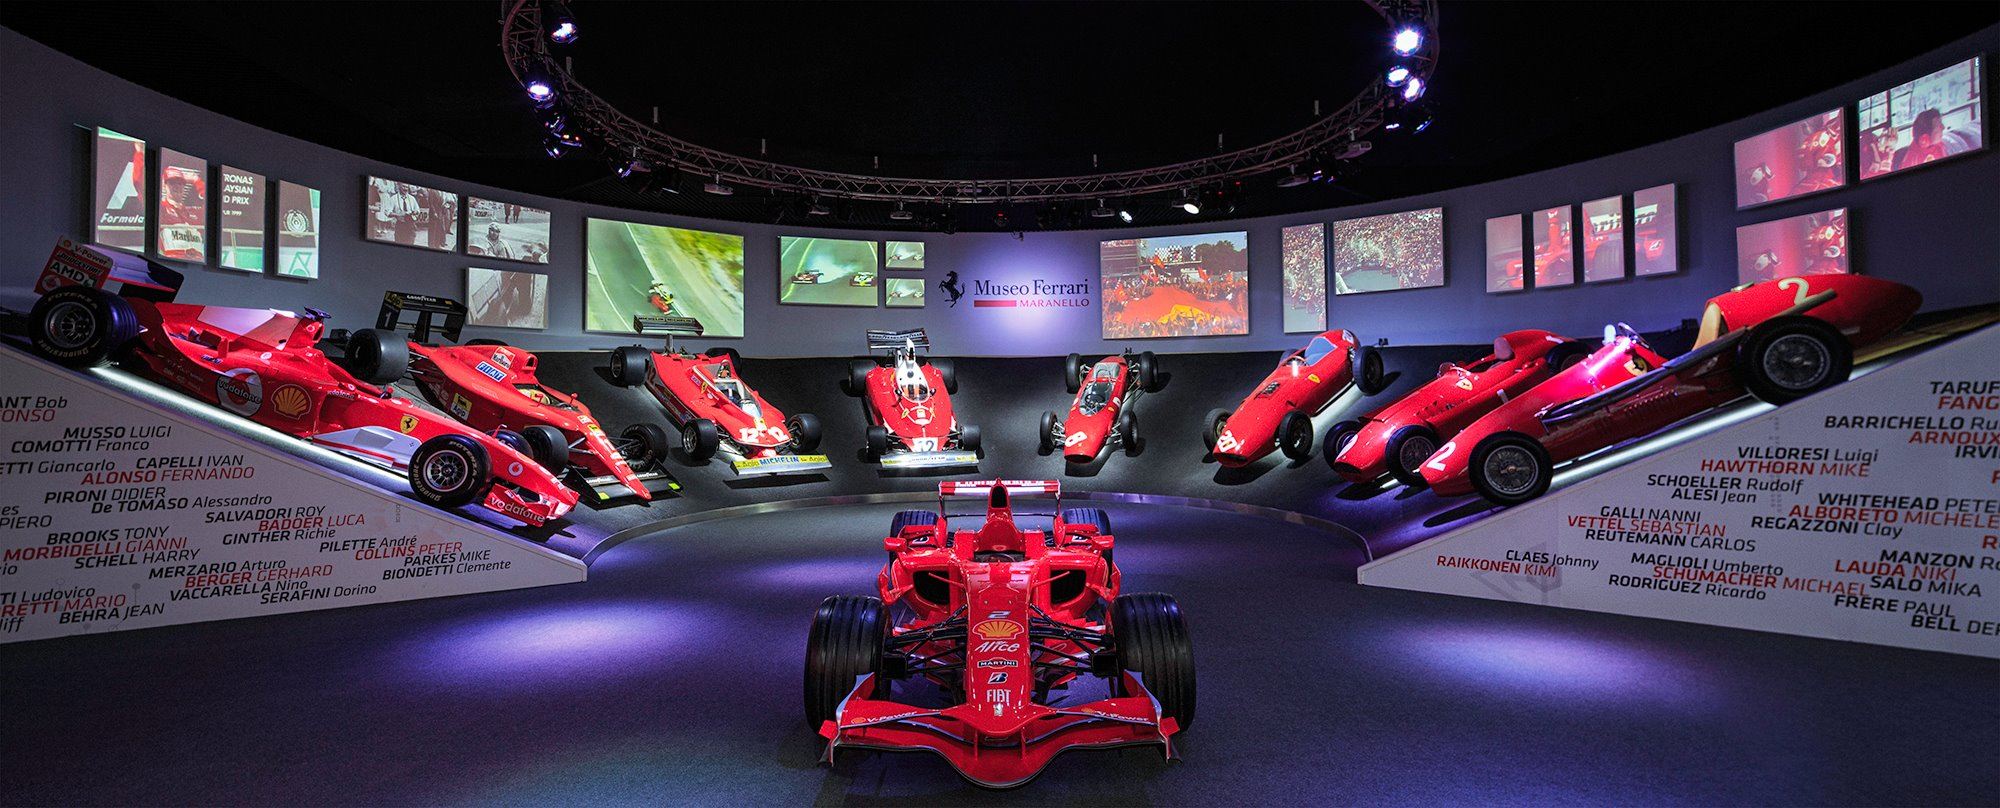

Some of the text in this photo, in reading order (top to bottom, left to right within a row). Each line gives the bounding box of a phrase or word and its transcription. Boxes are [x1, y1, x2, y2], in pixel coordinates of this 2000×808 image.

[232, 196, 250, 205] PRIX
[100, 213, 145, 224] Formula
[50, 261, 85, 281] AMD
[973, 278, 1090, 296] Museo Ferrari
[1778, 277, 1811, 305] 2
[1019, 298, 1090, 308] MARANELLO
[478, 362, 506, 381] FIAT
[35, 396, 68, 409] Bob
[1937, 395, 2000, 410] FANG
[0, 409, 55, 422] ONSO
[1824, 415, 1965, 430] BARRICHELLO
[63, 425, 172, 440] MUSSO LUIGI
[1908, 431, 2000, 445] ARNOUX
[11, 440, 150, 453] COMOTTI Franco
[1737, 446, 1879, 465] VILLORESI Luigi
[1955, 445, 2000, 459] IRVI
[135, 455, 244, 470] CAPELLI IVAN
[760, 456, 799, 466] MICHELIN
[1427, 441, 1457, 472] 2
[38, 459, 116, 474] Giancarlo
[80, 467, 255, 485] ALONSO FERNANDO
[1701, 459, 1870, 477] HAWTHORN MIKE
[1647, 474, 1804, 495] SCHOELLER Rudolf
[44, 486, 166, 504] PIRONI DIDIER
[91, 493, 272, 514] De TOMASO Alessandro
[1671, 488, 1757, 504] ALESI Jean
[1818, 493, 2000, 514] WHITEHEAD PETE
[205, 505, 326, 524] SALVADORI ROY
[490, 496, 546, 523] vodafone
[1600, 506, 1701, 522] GALLI NANNI
[1788, 505, 2000, 529] ALBORETO MICHELE
[0, 515, 53, 529] PIERO
[258, 513, 365, 532] BADOER LUCA
[1568, 515, 1726, 537] VETTEL SEBASTIAN
[1750, 516, 1903, 540] REGAZZONI Clay
[46, 525, 169, 546] BROOKS TONY
[222, 527, 336, 546] GINTHER Richie
[319, 535, 417, 553] PILETTE André
[1585, 528, 1756, 552] REUTEMANN CARLOS
[3, 536, 187, 562] MORBIDELLI GIANNI
[355, 541, 463, 561] COLLINS PETER
[403, 550, 491, 567] PARKES MIKE
[74, 548, 201, 570] SCHELL HARRY
[1436, 555, 1557, 578] RAIKKONEN KIMI
[1505, 549, 1599, 571] CLAES Johnny
[1630, 552, 1784, 577] MAGLIOLI Umberto
[1879, 549, 1975, 569] MANZON
[148, 559, 287, 580] MERZARIO Arturo
[184, 564, 333, 588] BERGER GERHARD
[382, 560, 511, 581] BIONDETTI Clemente
[1835, 560, 1956, 582] LAUDA NIKI
[170, 578, 309, 601] VACCARELLA Nino
[1608, 574, 1767, 601] RODRIGUEZ Ricardo
[1653, 565, 1869, 597] SCHUMACHER MICHAEL
[1869, 576, 1981, 598] SALO MIKA
[21, 587, 95, 602] Ludovico
[63, 594, 126, 612] MARIO
[260, 583, 377, 604] SERAFINI Dorino
[59, 603, 164, 626] BEHRA JEAN
[987, 610, 1012, 619] 2
[1834, 594, 1955, 619] FRERE PAUL
[1911, 615, 1961, 632] BELL
[986, 689, 1012, 706] FIAT
[866, 710, 917, 723] V-Power
[1097, 711, 1150, 723] V-Power
